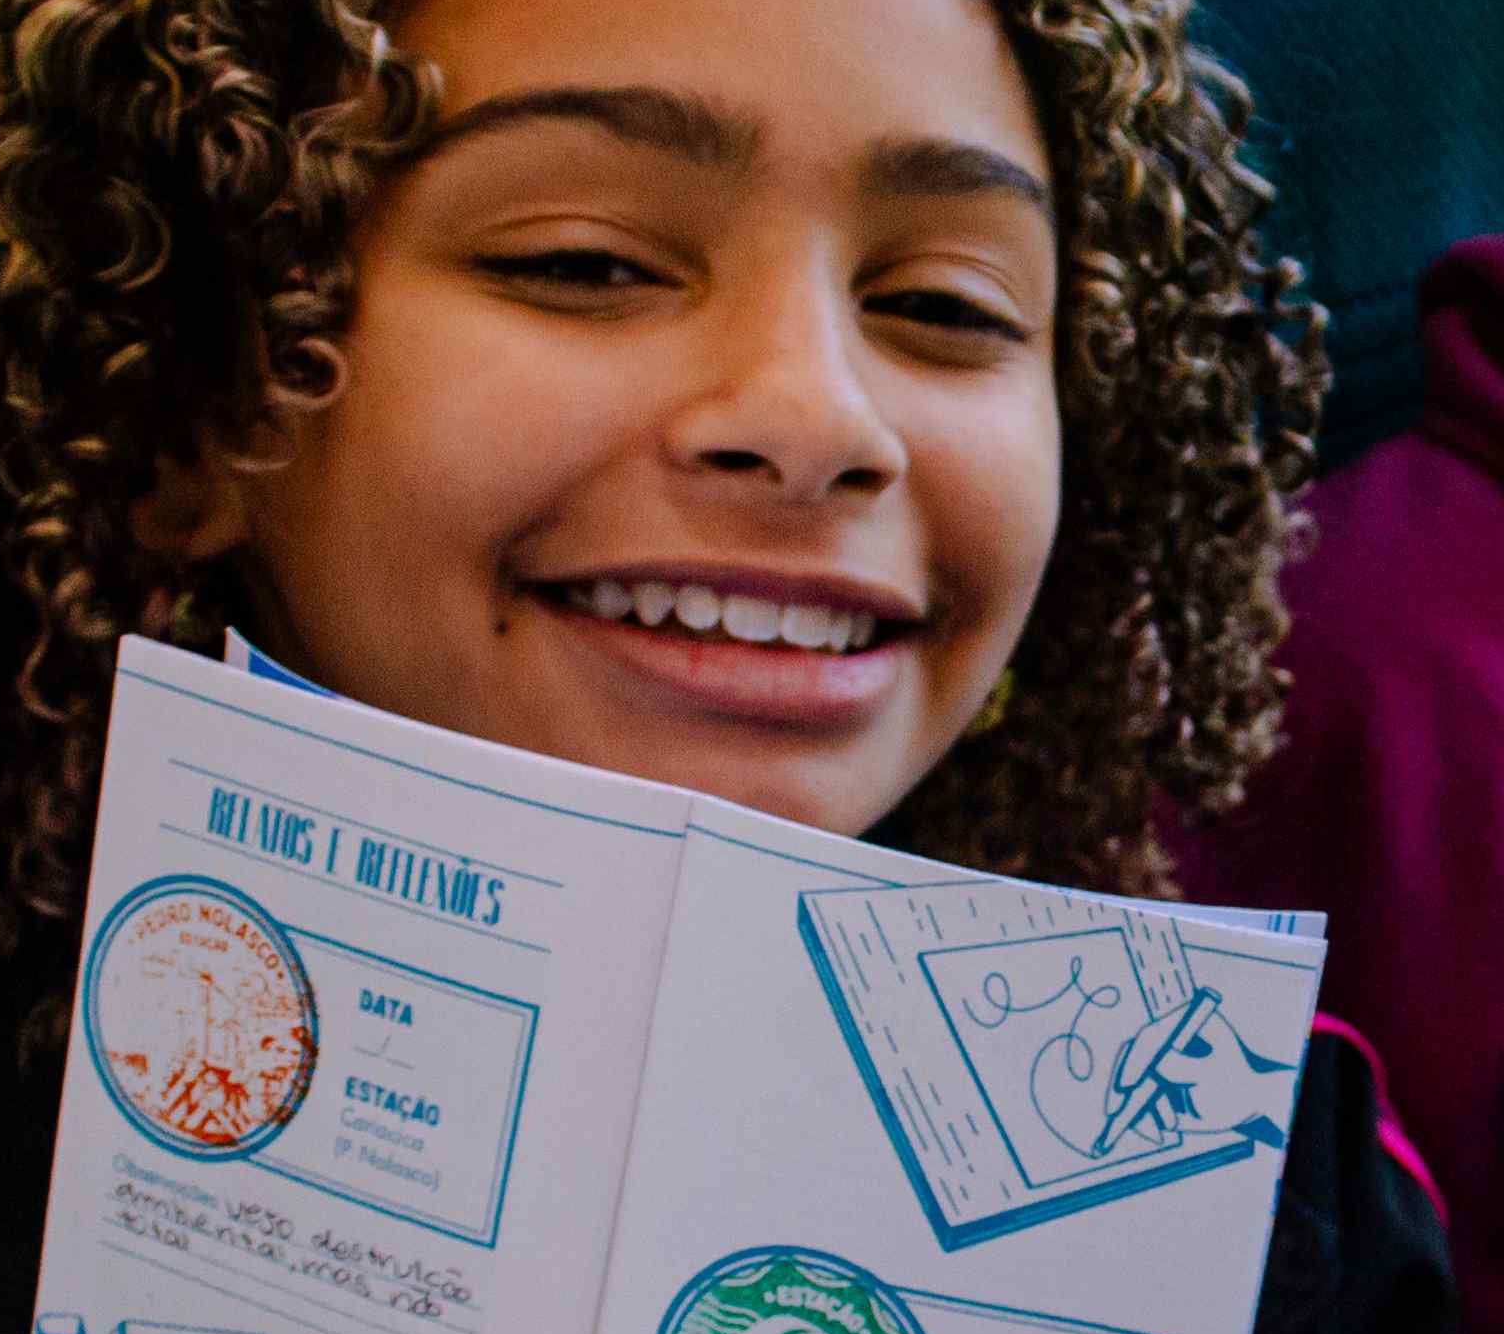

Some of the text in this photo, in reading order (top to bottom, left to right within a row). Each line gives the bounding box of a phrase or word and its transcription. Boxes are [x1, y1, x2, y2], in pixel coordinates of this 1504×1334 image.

[206, 784, 316, 866] RELATOS
[324, 826, 342, 874] E
[198, 903, 280, 969] NOLASCO
[358, 987, 414, 1027] DATA
[344, 1075, 441, 1128] ESTAÇÃO
